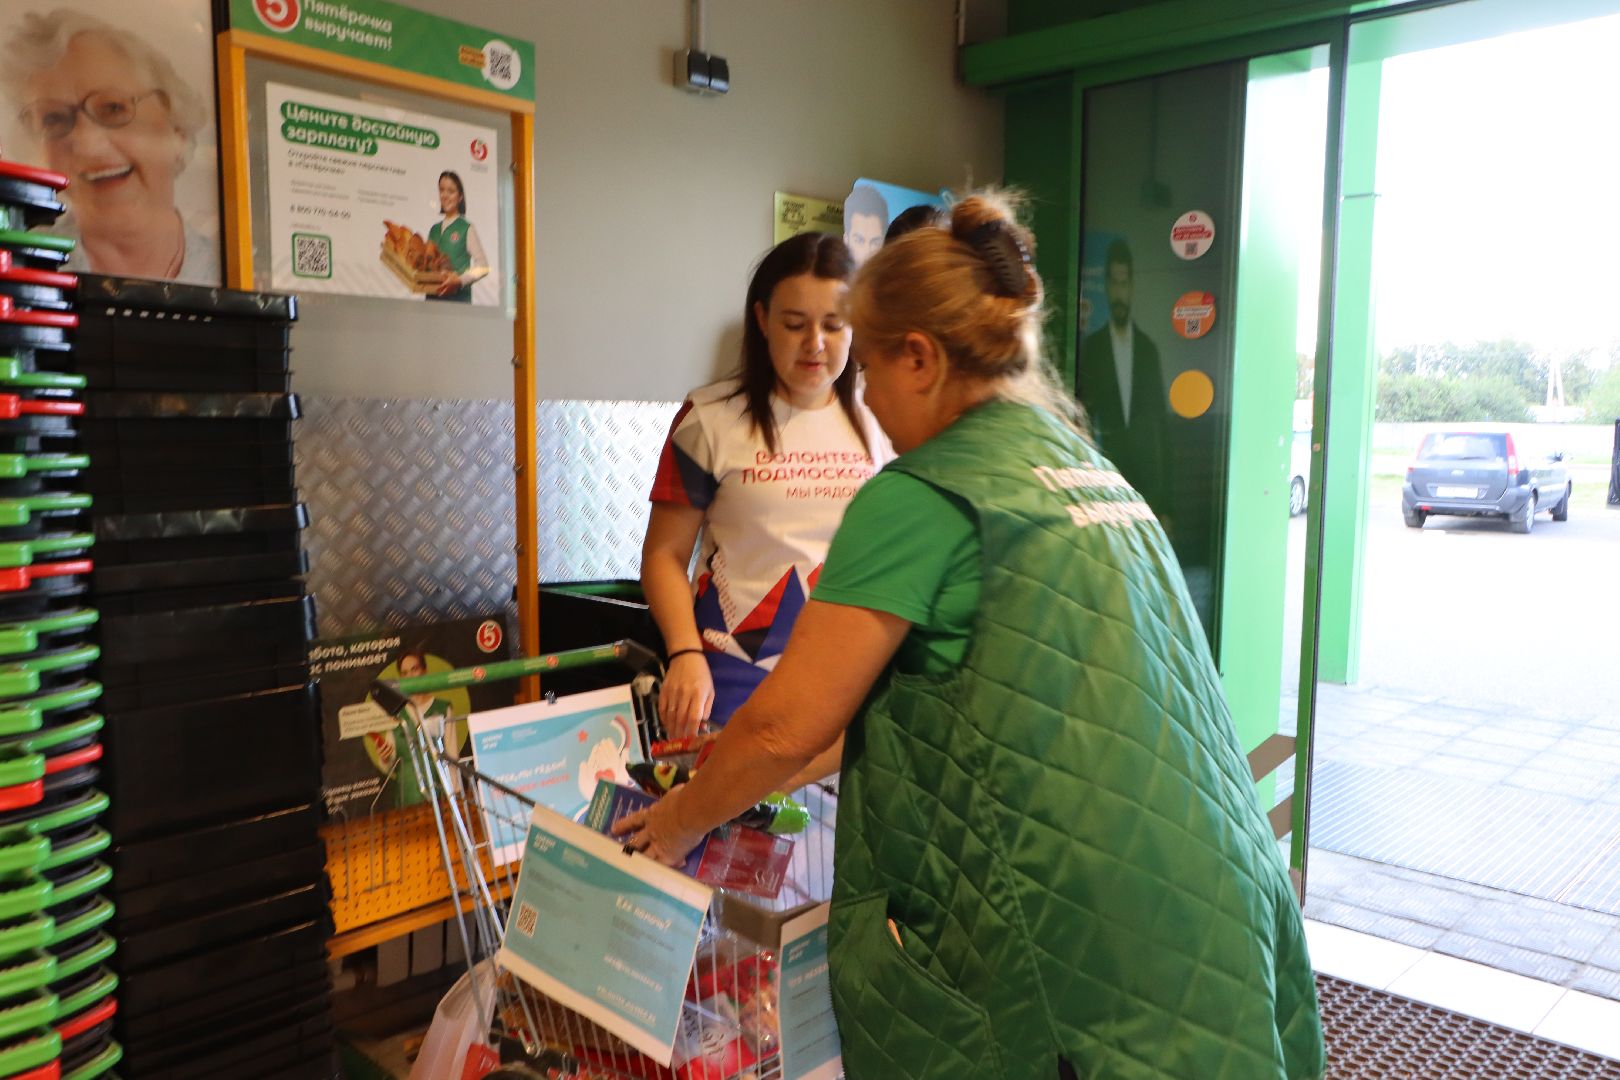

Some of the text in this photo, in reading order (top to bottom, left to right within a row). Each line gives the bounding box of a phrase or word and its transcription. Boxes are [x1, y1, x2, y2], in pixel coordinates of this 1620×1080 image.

[304, 0, 392, 33] Пятёрочка
[304, 16, 393, 52] выручает!
[286, 102, 436, 147] Цените достойную
[286, 125, 373, 153] зарплату?
[786, 487, 810, 499] МЫ
